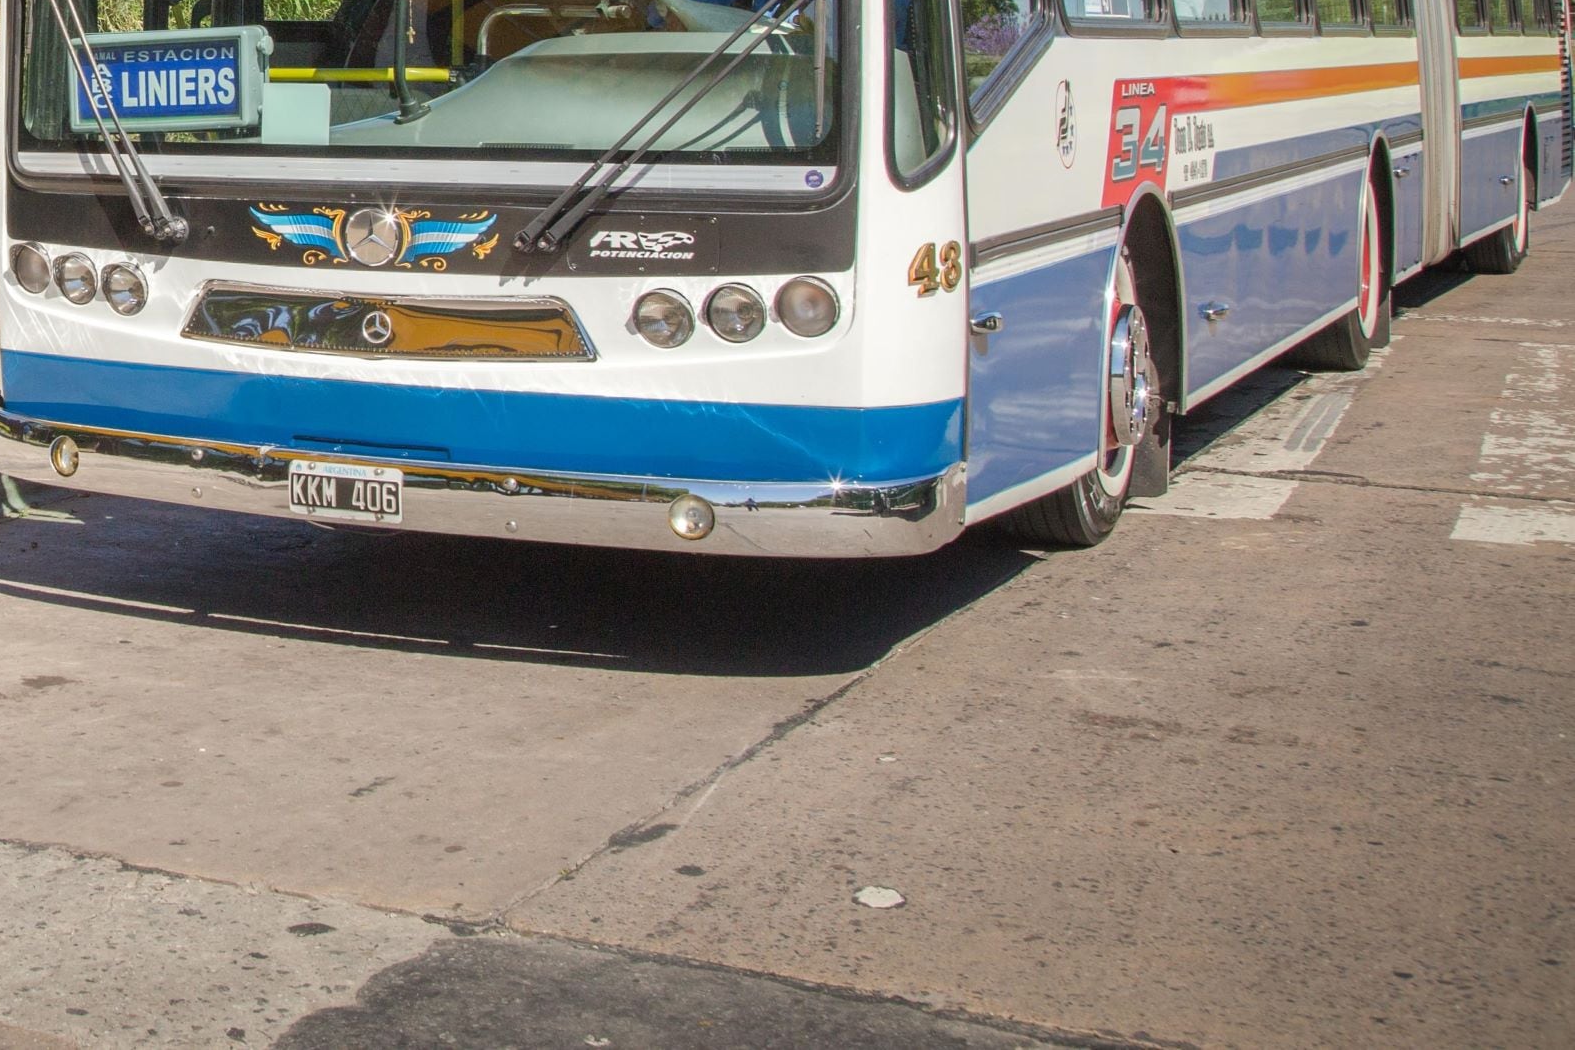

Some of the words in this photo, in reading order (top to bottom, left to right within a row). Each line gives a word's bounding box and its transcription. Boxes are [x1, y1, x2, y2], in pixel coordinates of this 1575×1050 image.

[89, 52, 116, 62] AMAL
[123, 47, 234, 63] ESTACION
[121, 67, 236, 108] LINIERS
[1121, 82, 1156, 97] LINEA
[1111, 102, 1167, 183] 34
[589, 250, 695, 260] POTENCIACION
[324, 466, 367, 477] ARGENTINA
[292, 474, 337, 508] KKM
[351, 480, 397, 513] 406
